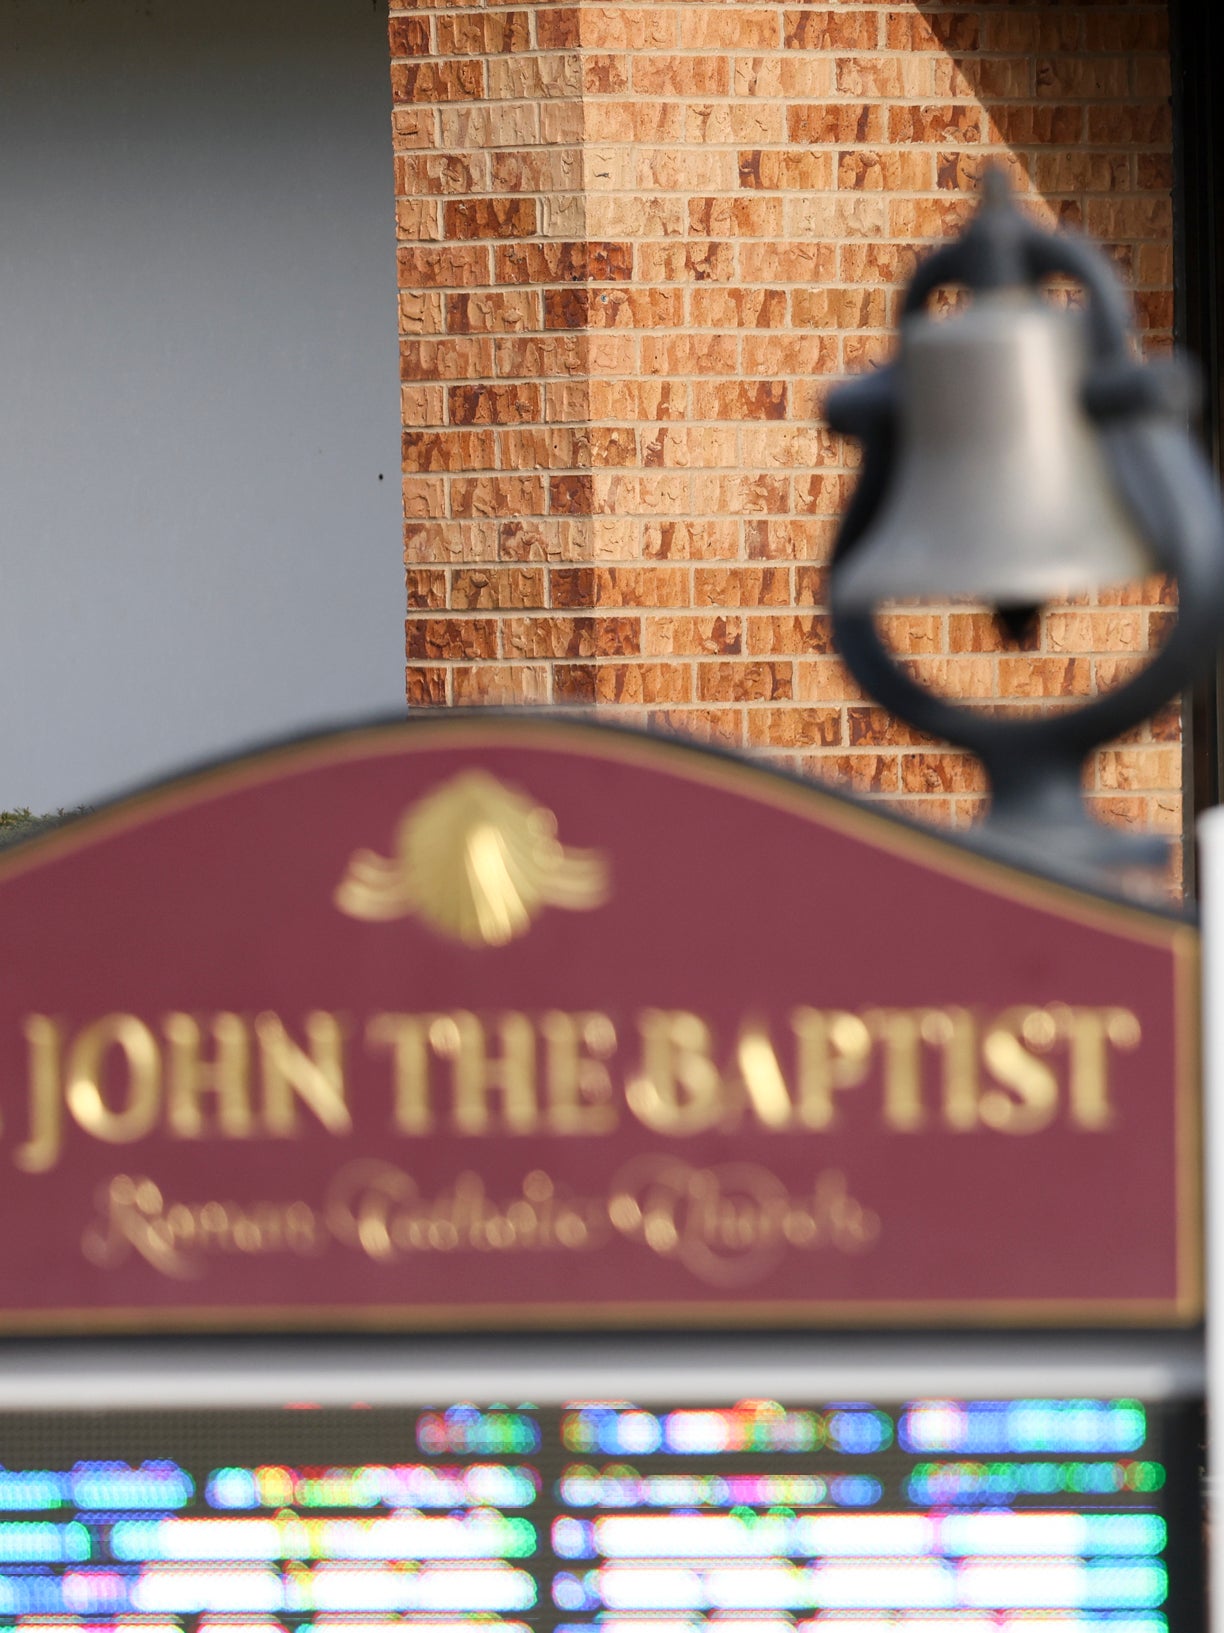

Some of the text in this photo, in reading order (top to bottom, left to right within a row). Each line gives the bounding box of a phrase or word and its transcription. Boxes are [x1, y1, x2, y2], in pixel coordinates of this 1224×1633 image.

[16, 1003, 1141, 1172] JOHN THE BAPTIST
